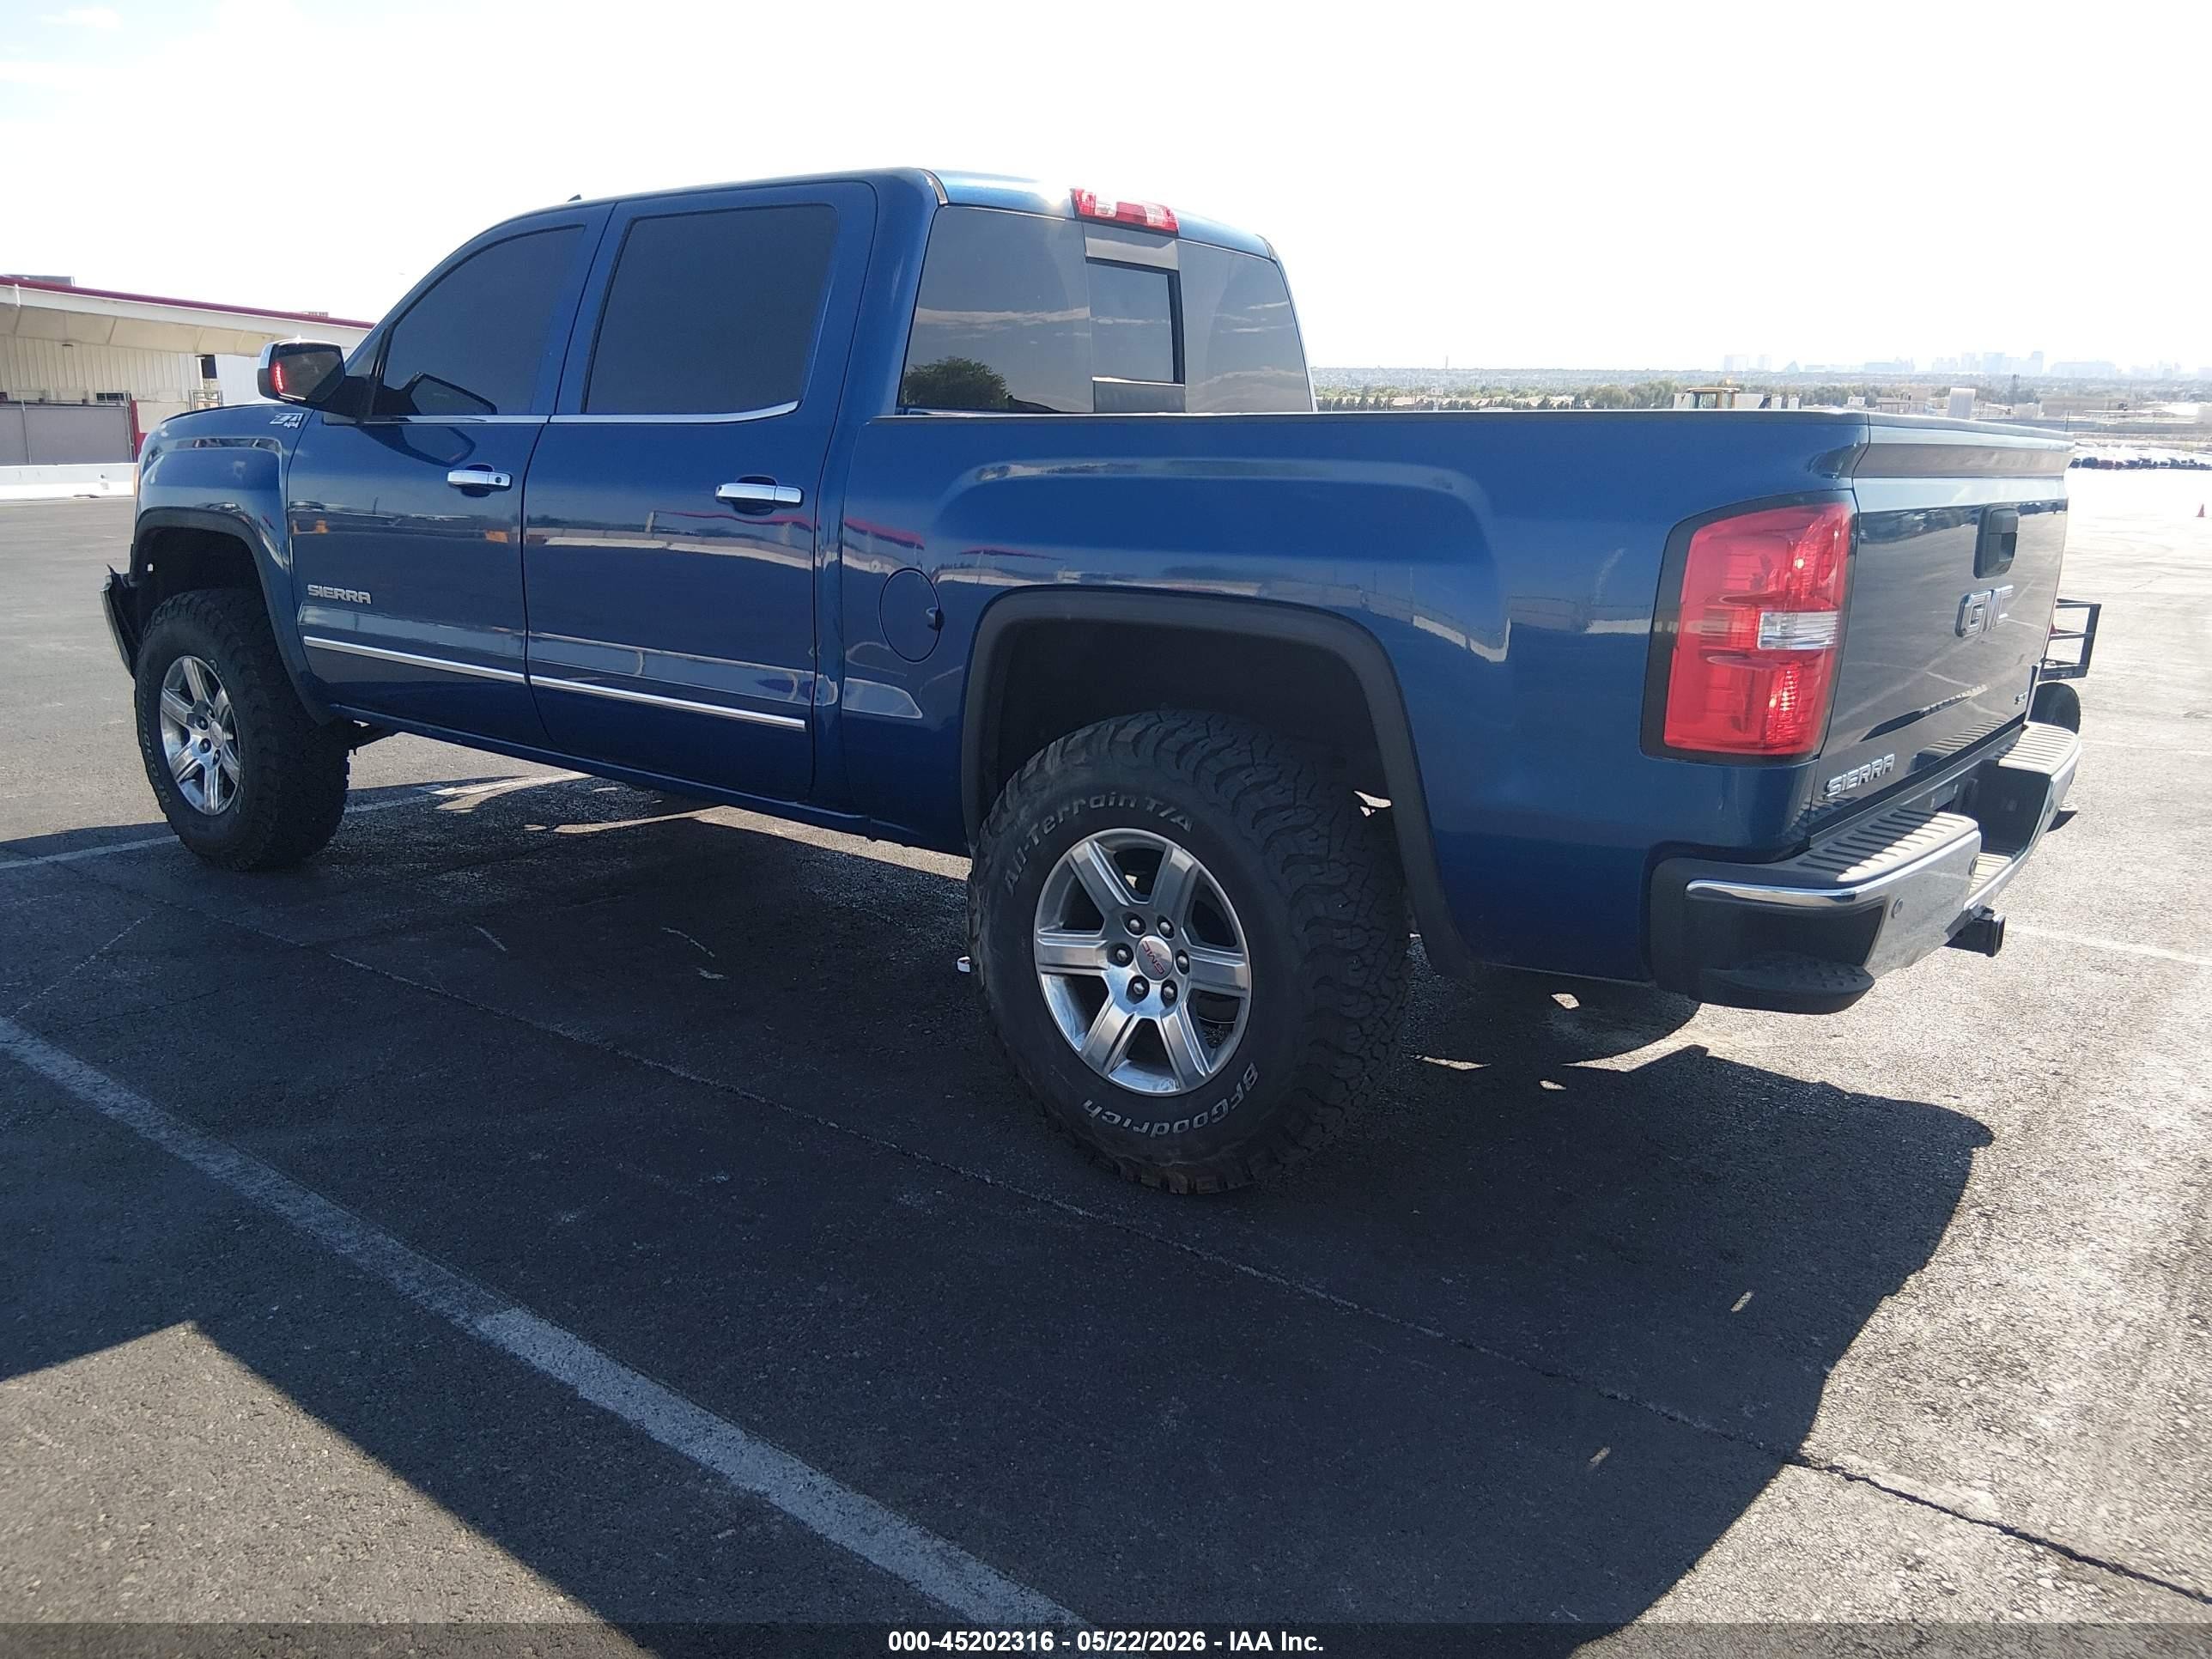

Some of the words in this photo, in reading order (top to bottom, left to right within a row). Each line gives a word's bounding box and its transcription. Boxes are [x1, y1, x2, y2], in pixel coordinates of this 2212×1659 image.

[307, 584, 372, 605] SIERRA
[1956, 585, 2014, 637] GMC
[1826, 753, 1894, 797] SIERRA
[1005, 792, 1137, 896] All-Terrain
[1144, 795, 1195, 833] T/A
[1142, 940, 1164, 975] GMC
[1083, 1062, 1259, 1138] BFGoodrich
